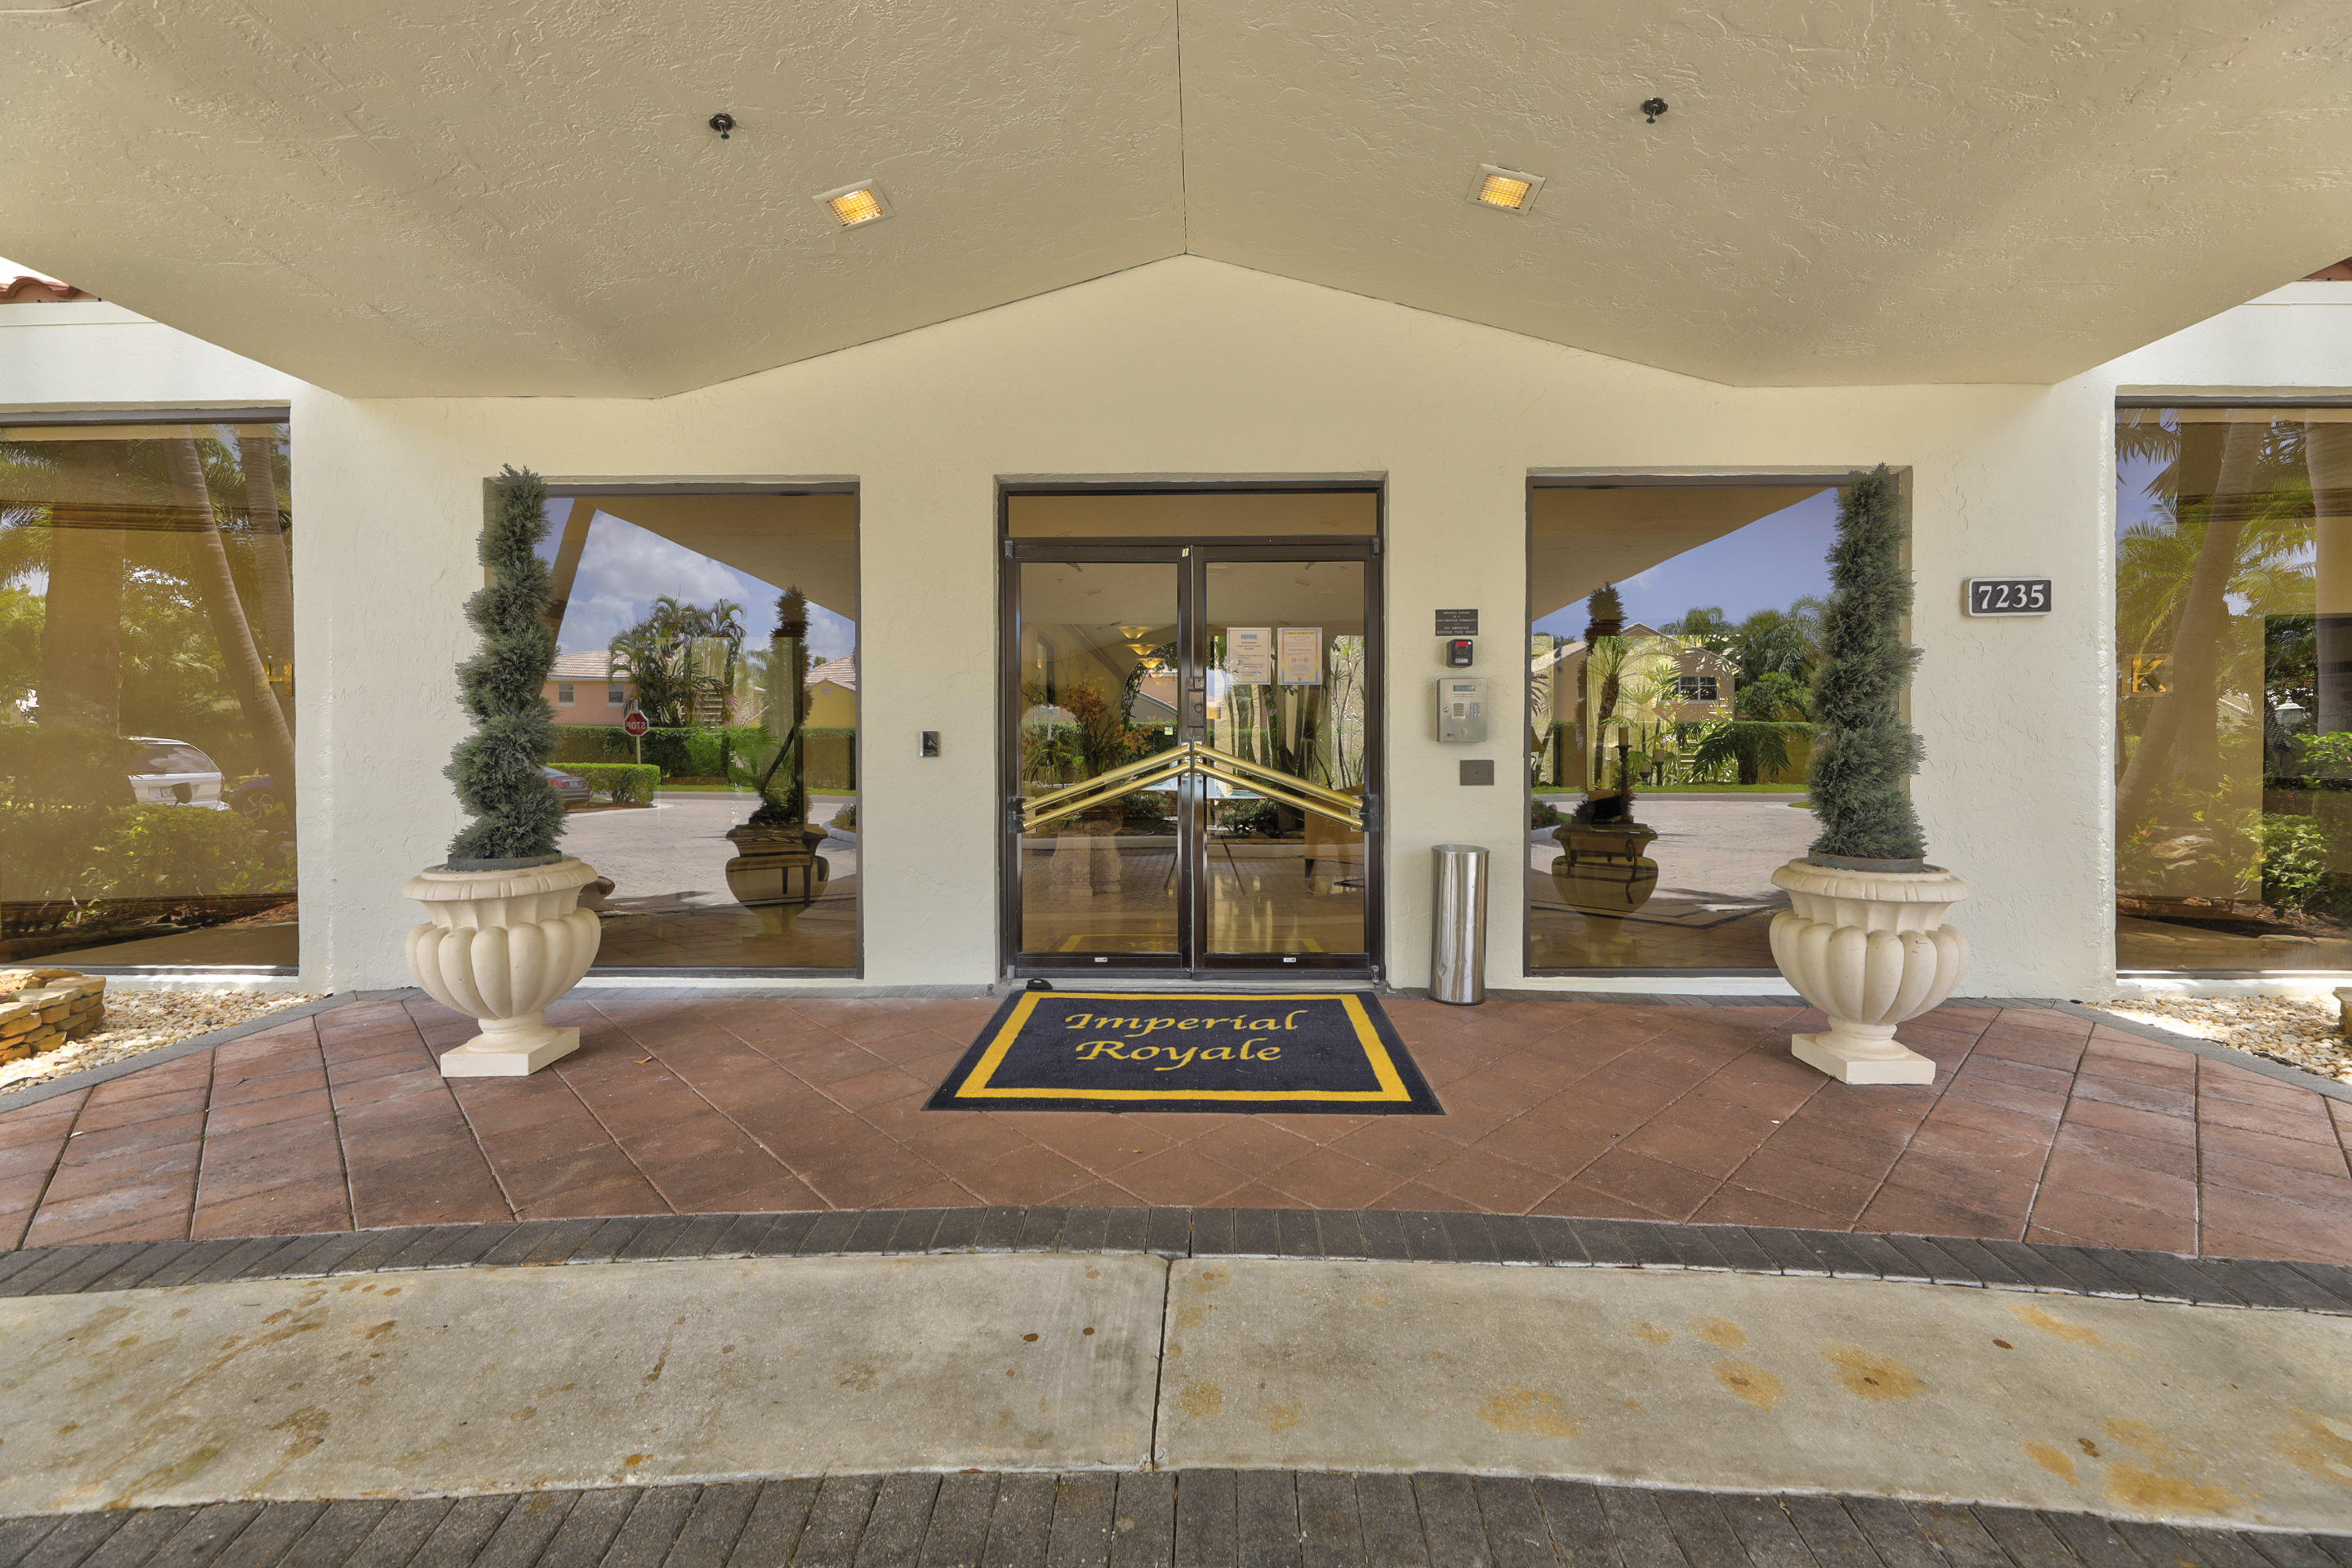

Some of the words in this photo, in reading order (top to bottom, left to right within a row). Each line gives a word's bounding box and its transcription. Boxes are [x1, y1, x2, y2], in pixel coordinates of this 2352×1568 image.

[1978, 584, 2045, 609] 7235
[1065, 1009, 1309, 1038] Imperial
[1076, 1038, 1282, 1071] Royale
